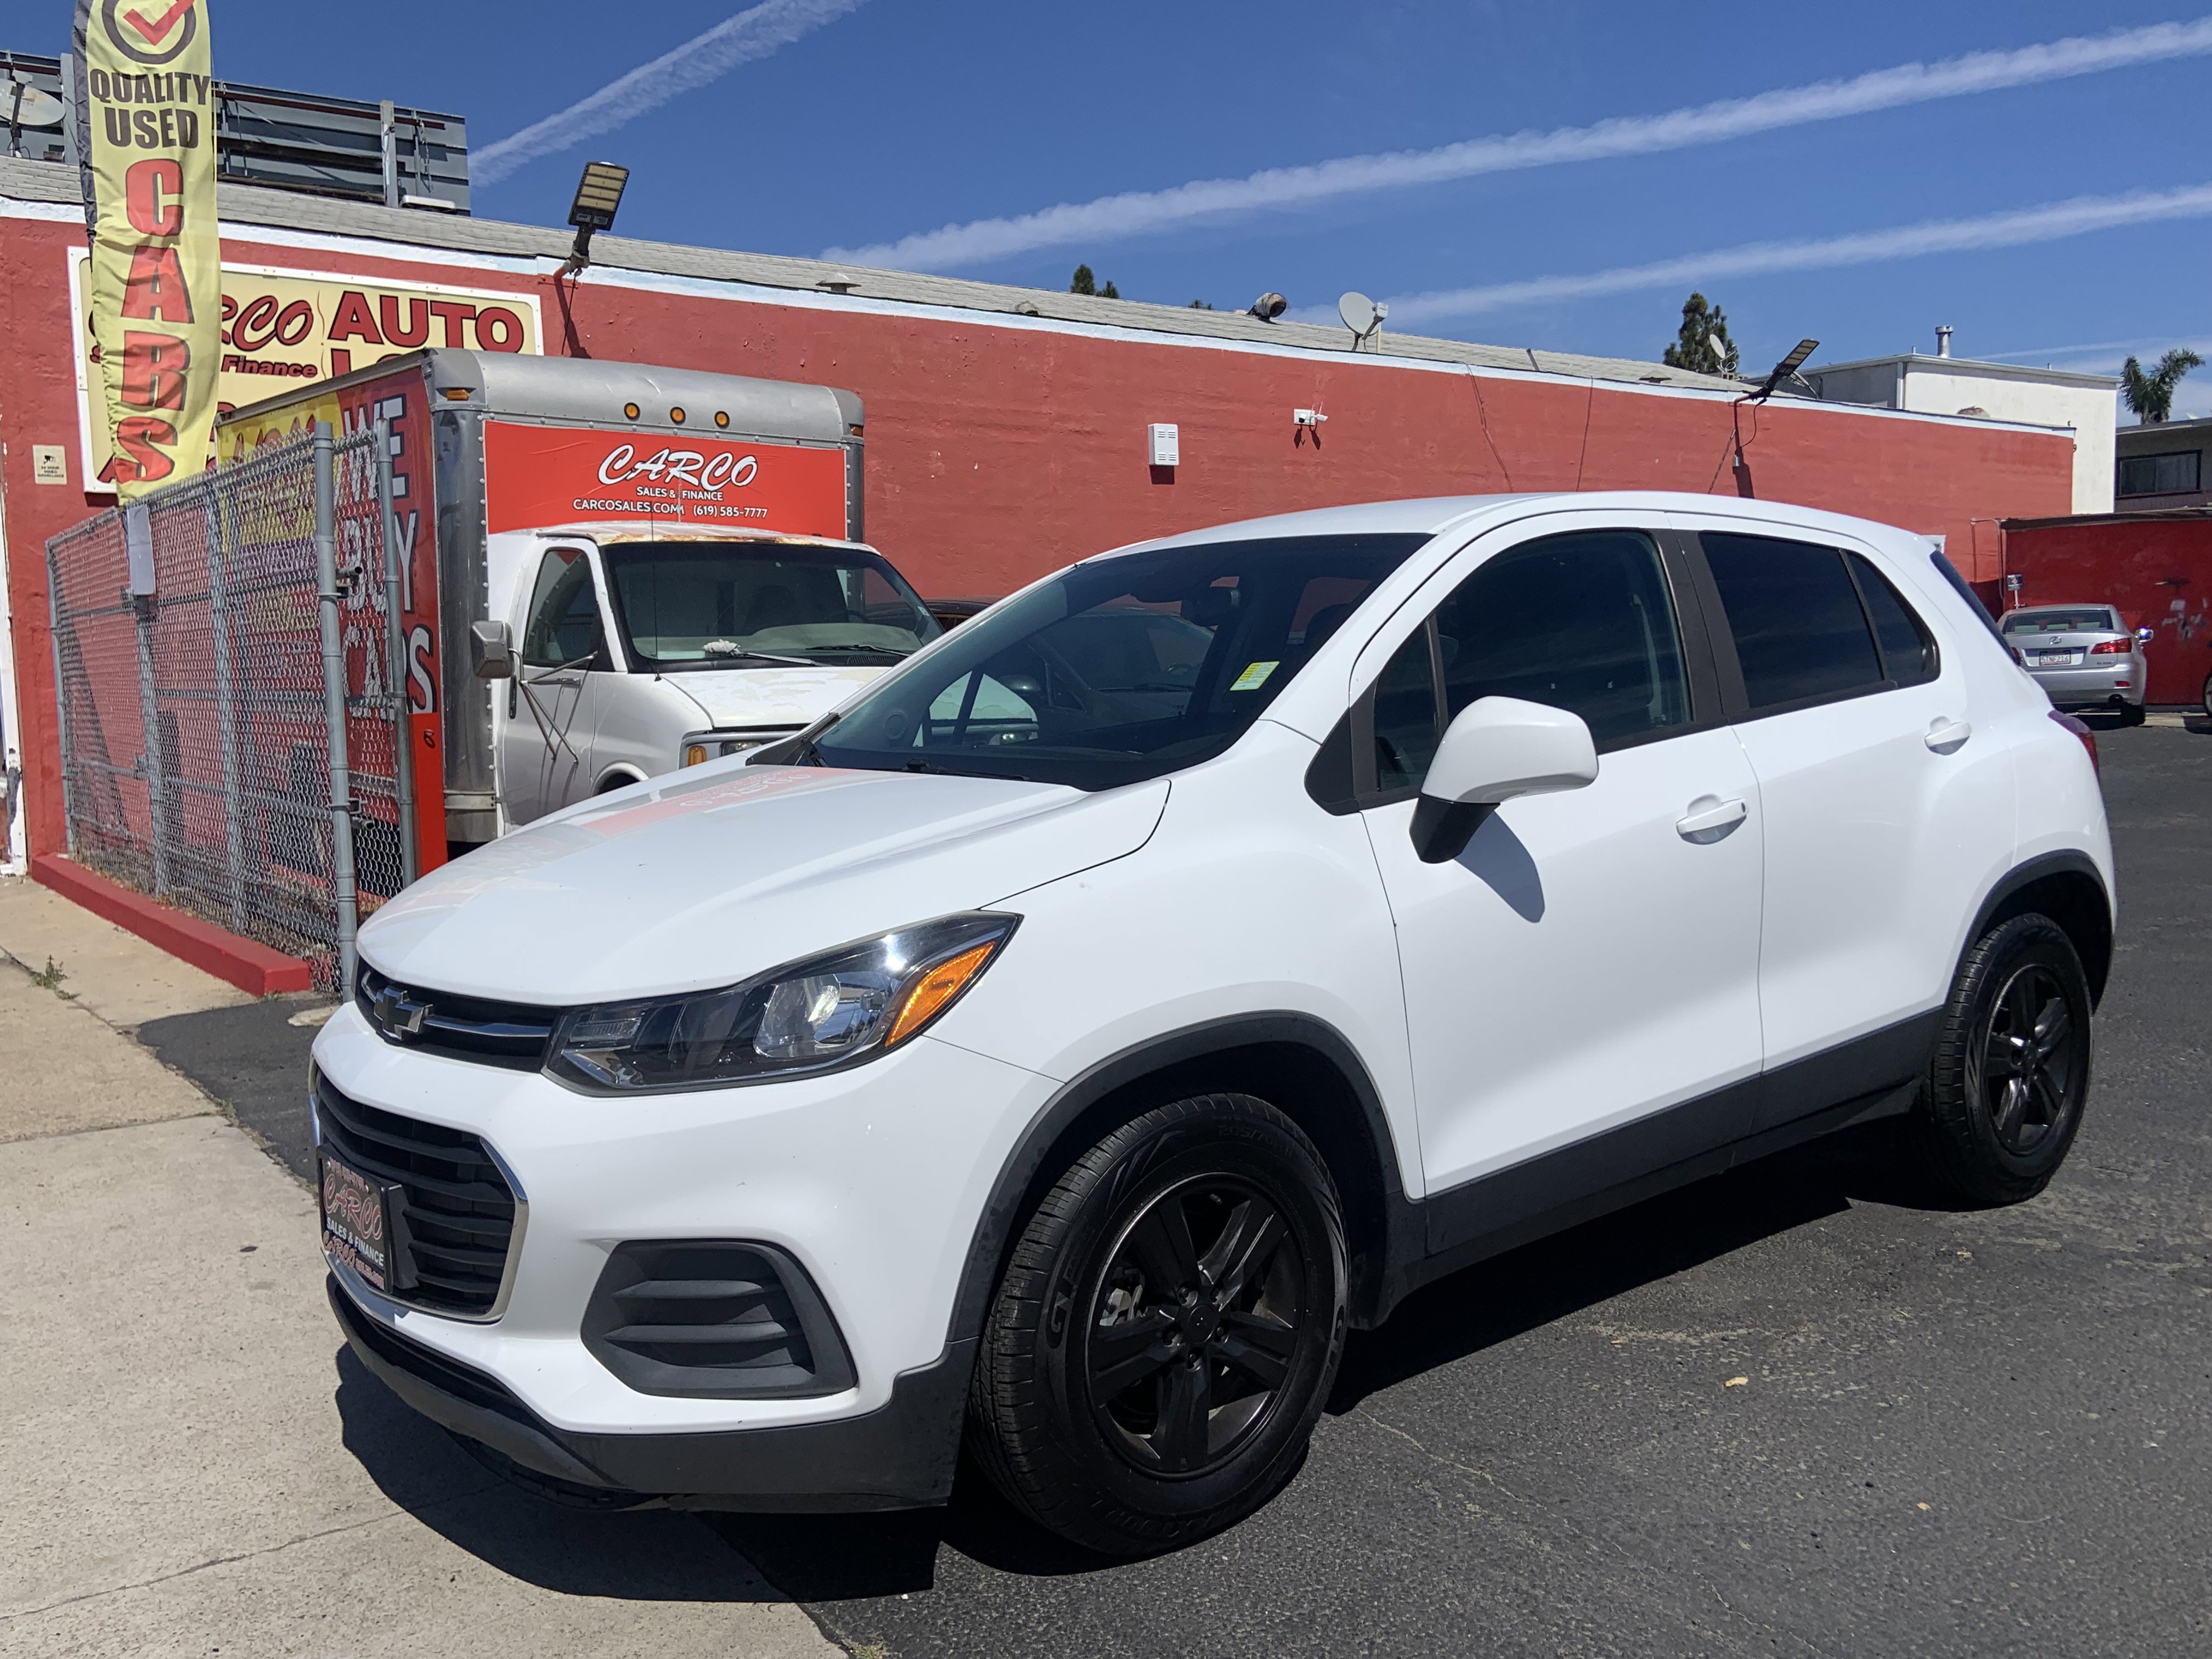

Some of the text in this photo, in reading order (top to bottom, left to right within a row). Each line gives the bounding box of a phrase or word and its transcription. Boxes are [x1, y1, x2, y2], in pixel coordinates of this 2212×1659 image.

[89, 68, 211, 105] QUALITY
[104, 107, 199, 149] USED
[114, 159, 195, 483] CARS
[328, 291, 524, 354] AUTO
[221, 354, 318, 378] Finance
[597, 443, 758, 492] CARCO
[572, 499, 768, 518] CARCOSALES.COM (619) 585-7777
[636, 486, 723, 501] SALES & FINANCE
[323, 1173, 383, 1240] CARCO
[326, 1217, 347, 1240] SALES
[354, 1236, 385, 1267] FINANCE
